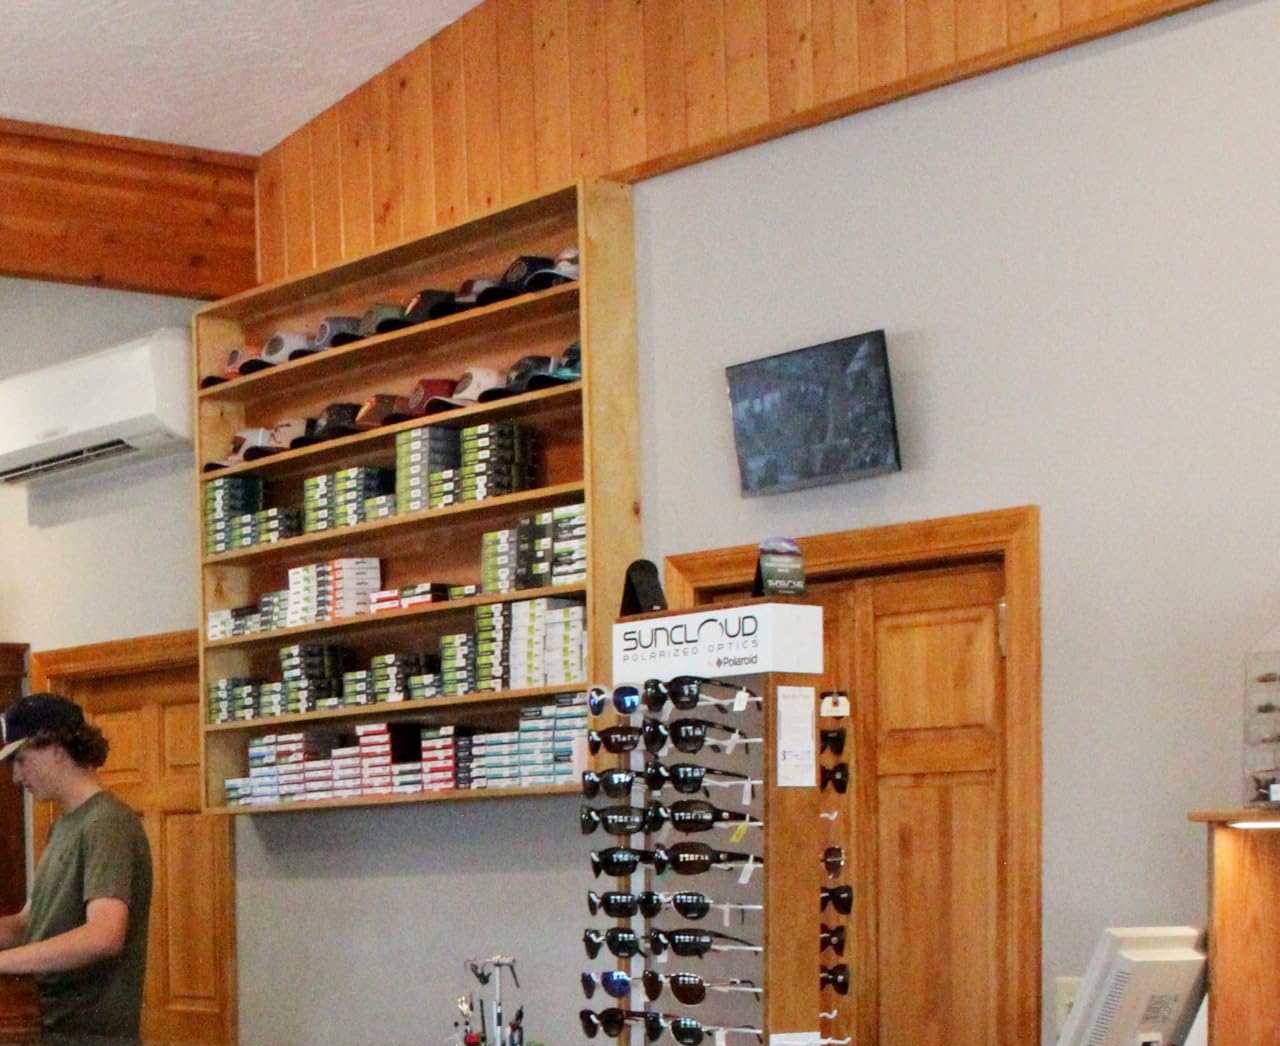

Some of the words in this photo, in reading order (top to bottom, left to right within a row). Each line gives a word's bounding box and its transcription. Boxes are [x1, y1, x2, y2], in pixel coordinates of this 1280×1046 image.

[623, 615, 758, 652] SUNCLOUD
[623, 646, 699, 663] POLARIZED
[707, 639, 759, 653] OPTICS
[723, 655, 758, 668] Polaroid
